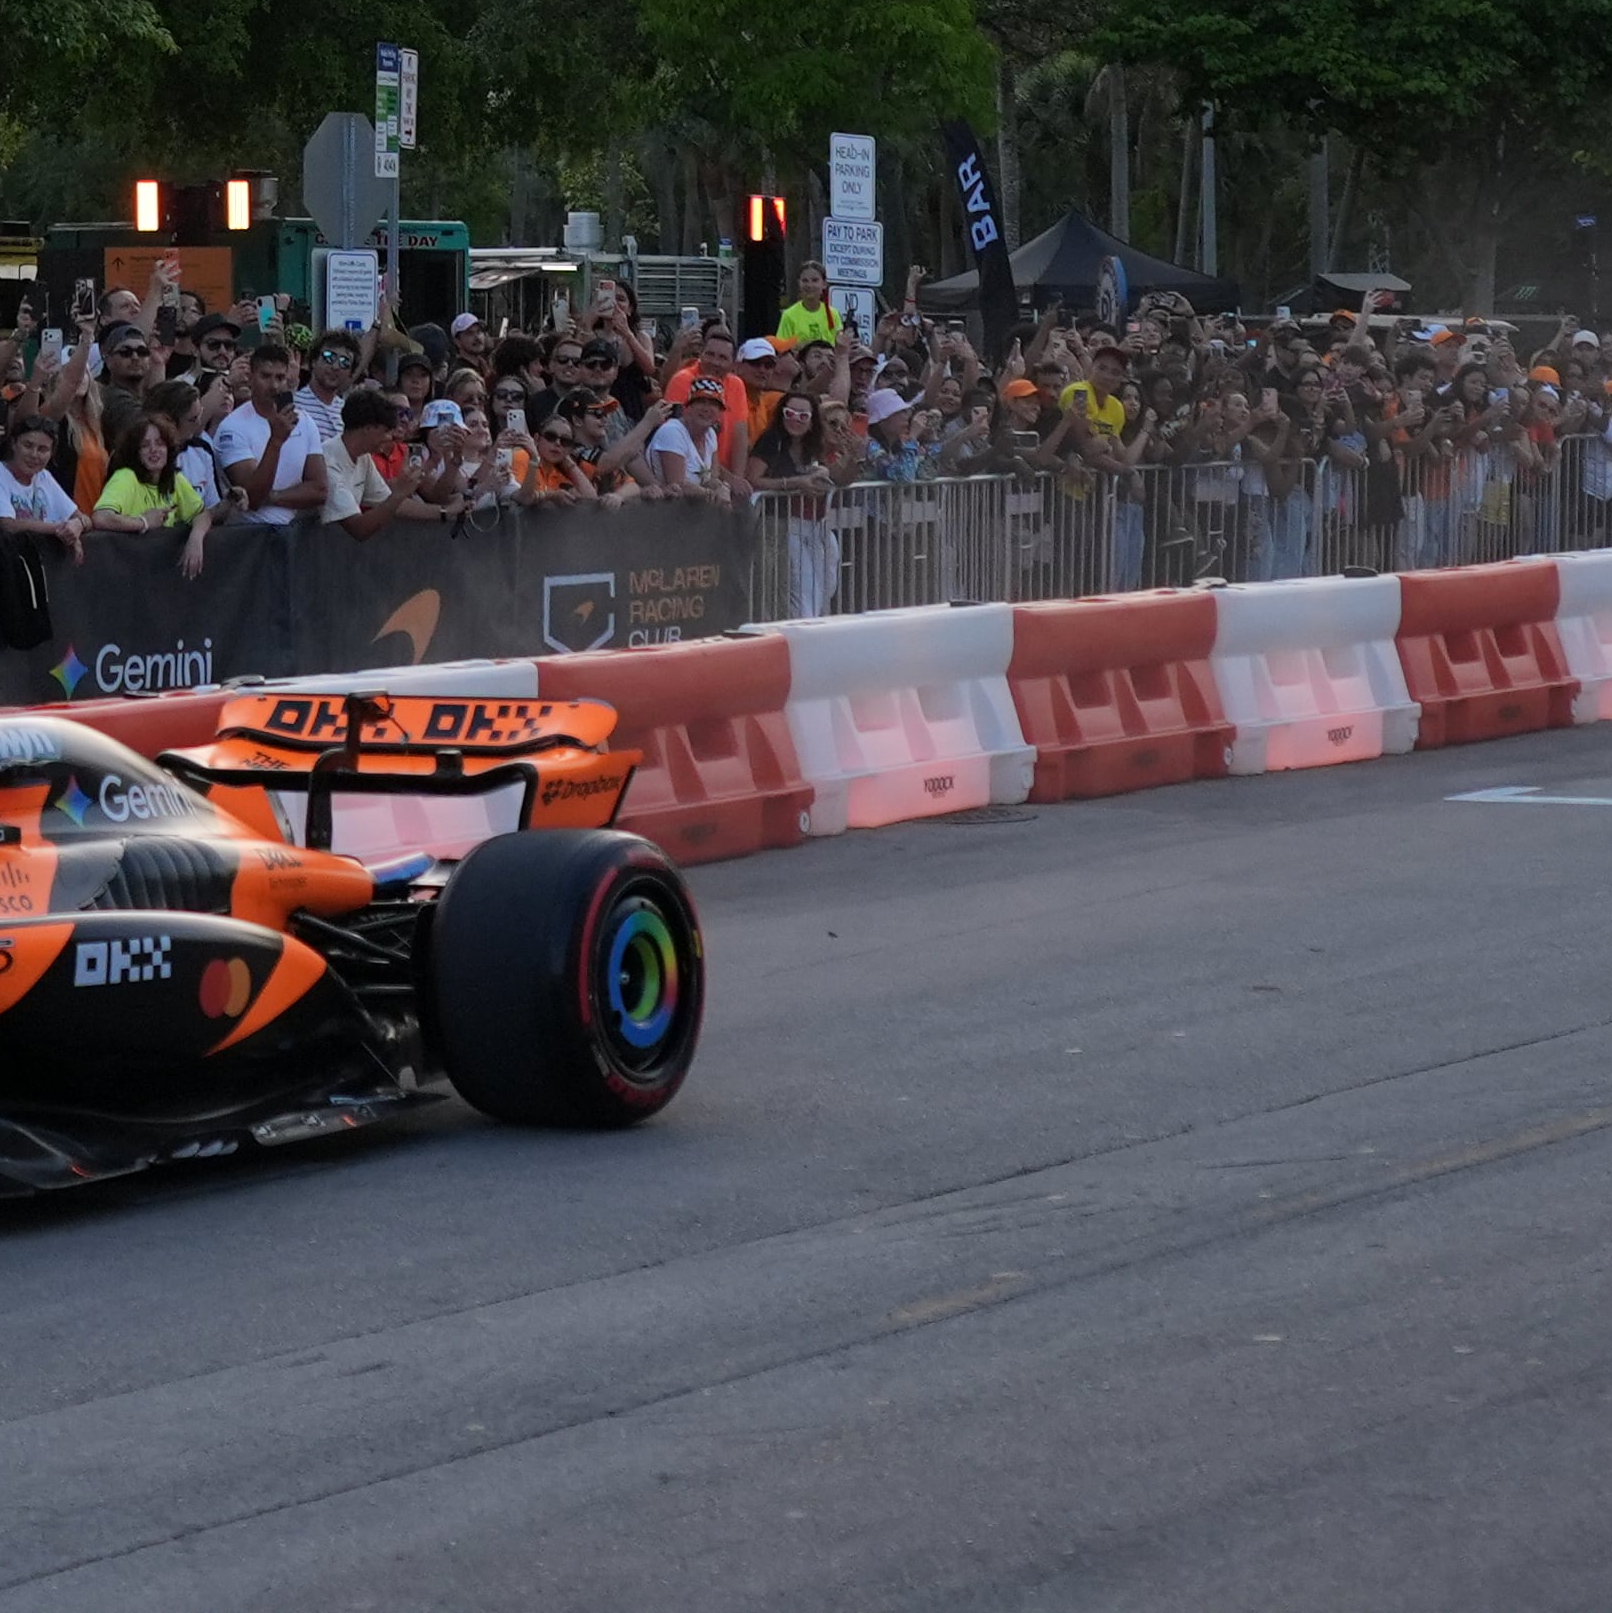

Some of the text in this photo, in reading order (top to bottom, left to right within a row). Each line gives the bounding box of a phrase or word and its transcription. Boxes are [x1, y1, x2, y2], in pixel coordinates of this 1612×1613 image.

[835, 145, 870, 162] HEAD-IN
[834, 163, 870, 179] PARKING
[841, 181, 862, 195] ONLY
[958, 152, 999, 251] BAR
[408, 235, 438, 247] DAY
[827, 225, 878, 243] PAY TO PARK
[830, 243, 851, 254] EXCEPT
[844, 292, 859, 311] NO
[630, 596, 705, 623] RACING
[95, 638, 212, 693] Gemini
[560, 775, 624, 800] Dropbox
[74, 935, 172, 987] OKX
